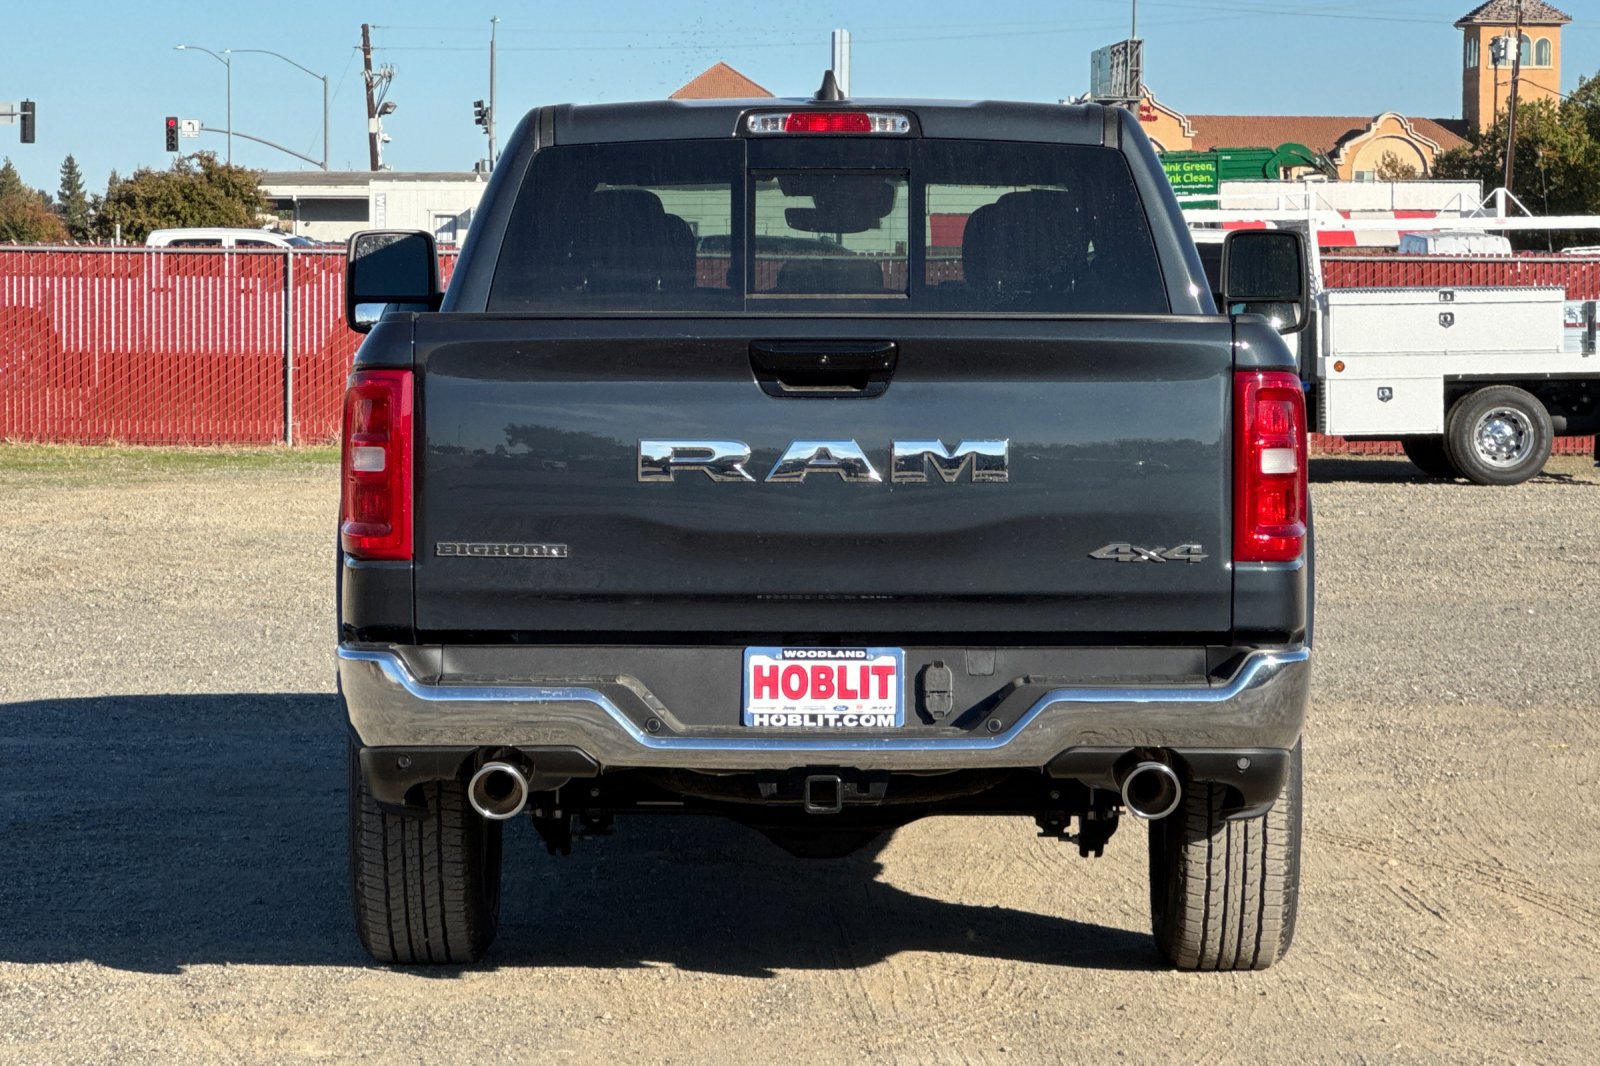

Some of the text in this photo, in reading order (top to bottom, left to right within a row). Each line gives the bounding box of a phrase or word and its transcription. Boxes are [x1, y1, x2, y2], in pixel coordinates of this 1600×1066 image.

[1183, 162, 1215, 172] Green,
[1183, 172, 1213, 183] Clean.
[638, 438, 1009, 483] RAM
[436, 542, 568, 558] BIGHORN
[1089, 543, 1208, 562] 4x4
[783, 650, 866, 659] WOODLAND
[753, 664, 896, 700] HOBLIT
[753, 714, 896, 727] HOBLIT.COM
